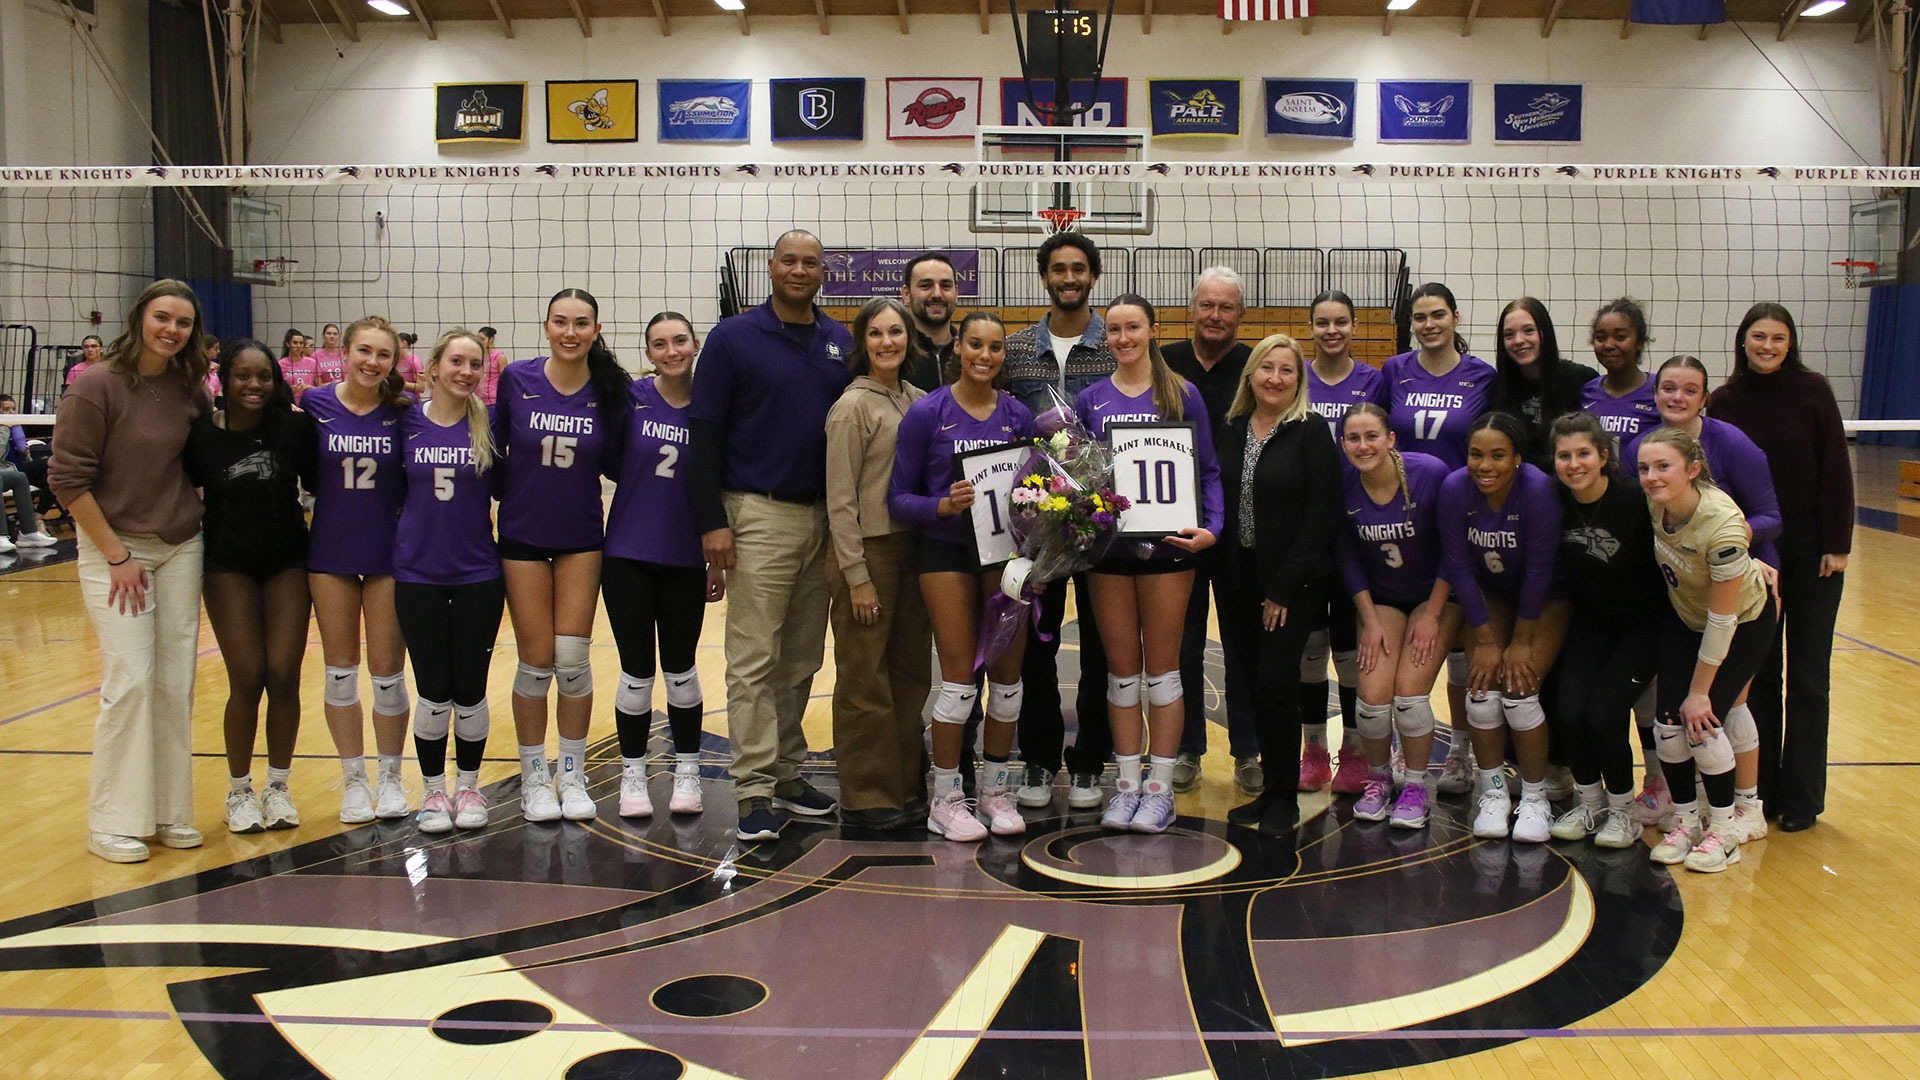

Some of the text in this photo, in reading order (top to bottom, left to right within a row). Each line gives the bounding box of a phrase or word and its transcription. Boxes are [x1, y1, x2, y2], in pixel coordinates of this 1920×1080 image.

[1054, 16, 1092, 36] 1:15
[807, 94, 828, 119] B
[1170, 104, 1223, 118] PACE
[456, 112, 501, 127] ADELPHI
[2, 168, 134, 181] URPLE KNIGHTS
[181, 167, 325, 179] PURPLE KNIGHTS
[374, 166, 522, 178] PURPLE KNIGHTS
[571, 165, 722, 177] PURPLE KNIGHTS
[773, 164, 927, 177] PURPLE KNIGHTS
[979, 164, 1133, 176] PURPLE KNIGHTS
[1184, 164, 1338, 177] PURPLE KNIGHTS
[1389, 166, 1542, 178] PURPLE KNIGHTS
[1593, 167, 1744, 179] PURPLE KNIGHTS
[1794, 168, 1920, 181] PURPLE KNIGH
[826, 269, 976, 282] THE KNIG NE
[1310, 402, 1353, 418] NIGHT
[1405, 393, 1463, 408] KNIGHTS
[529, 411, 593, 435] KNIGHTS
[642, 420, 690, 445] KNIGHT
[1413, 410, 1449, 440] 17
[1600, 416, 1640, 434] IGHTS
[328, 434, 392, 454] KNIGHTS
[540, 435, 579, 469] 15
[1112, 437, 1194, 457] SAINT MICHAEL'S
[414, 446, 476, 465] KNIGHTS
[655, 444, 680, 479] 2
[341, 457, 378, 490] 12
[1132, 460, 1177, 505] 10
[434, 467, 456, 501] 5
[983, 489, 1006, 536] 1
[1357, 521, 1416, 541] KNIGHTS
[1467, 527, 1517, 549] KNIGHTS
[1379, 542, 1404, 569] 3
[1483, 550, 1505, 574] 6
